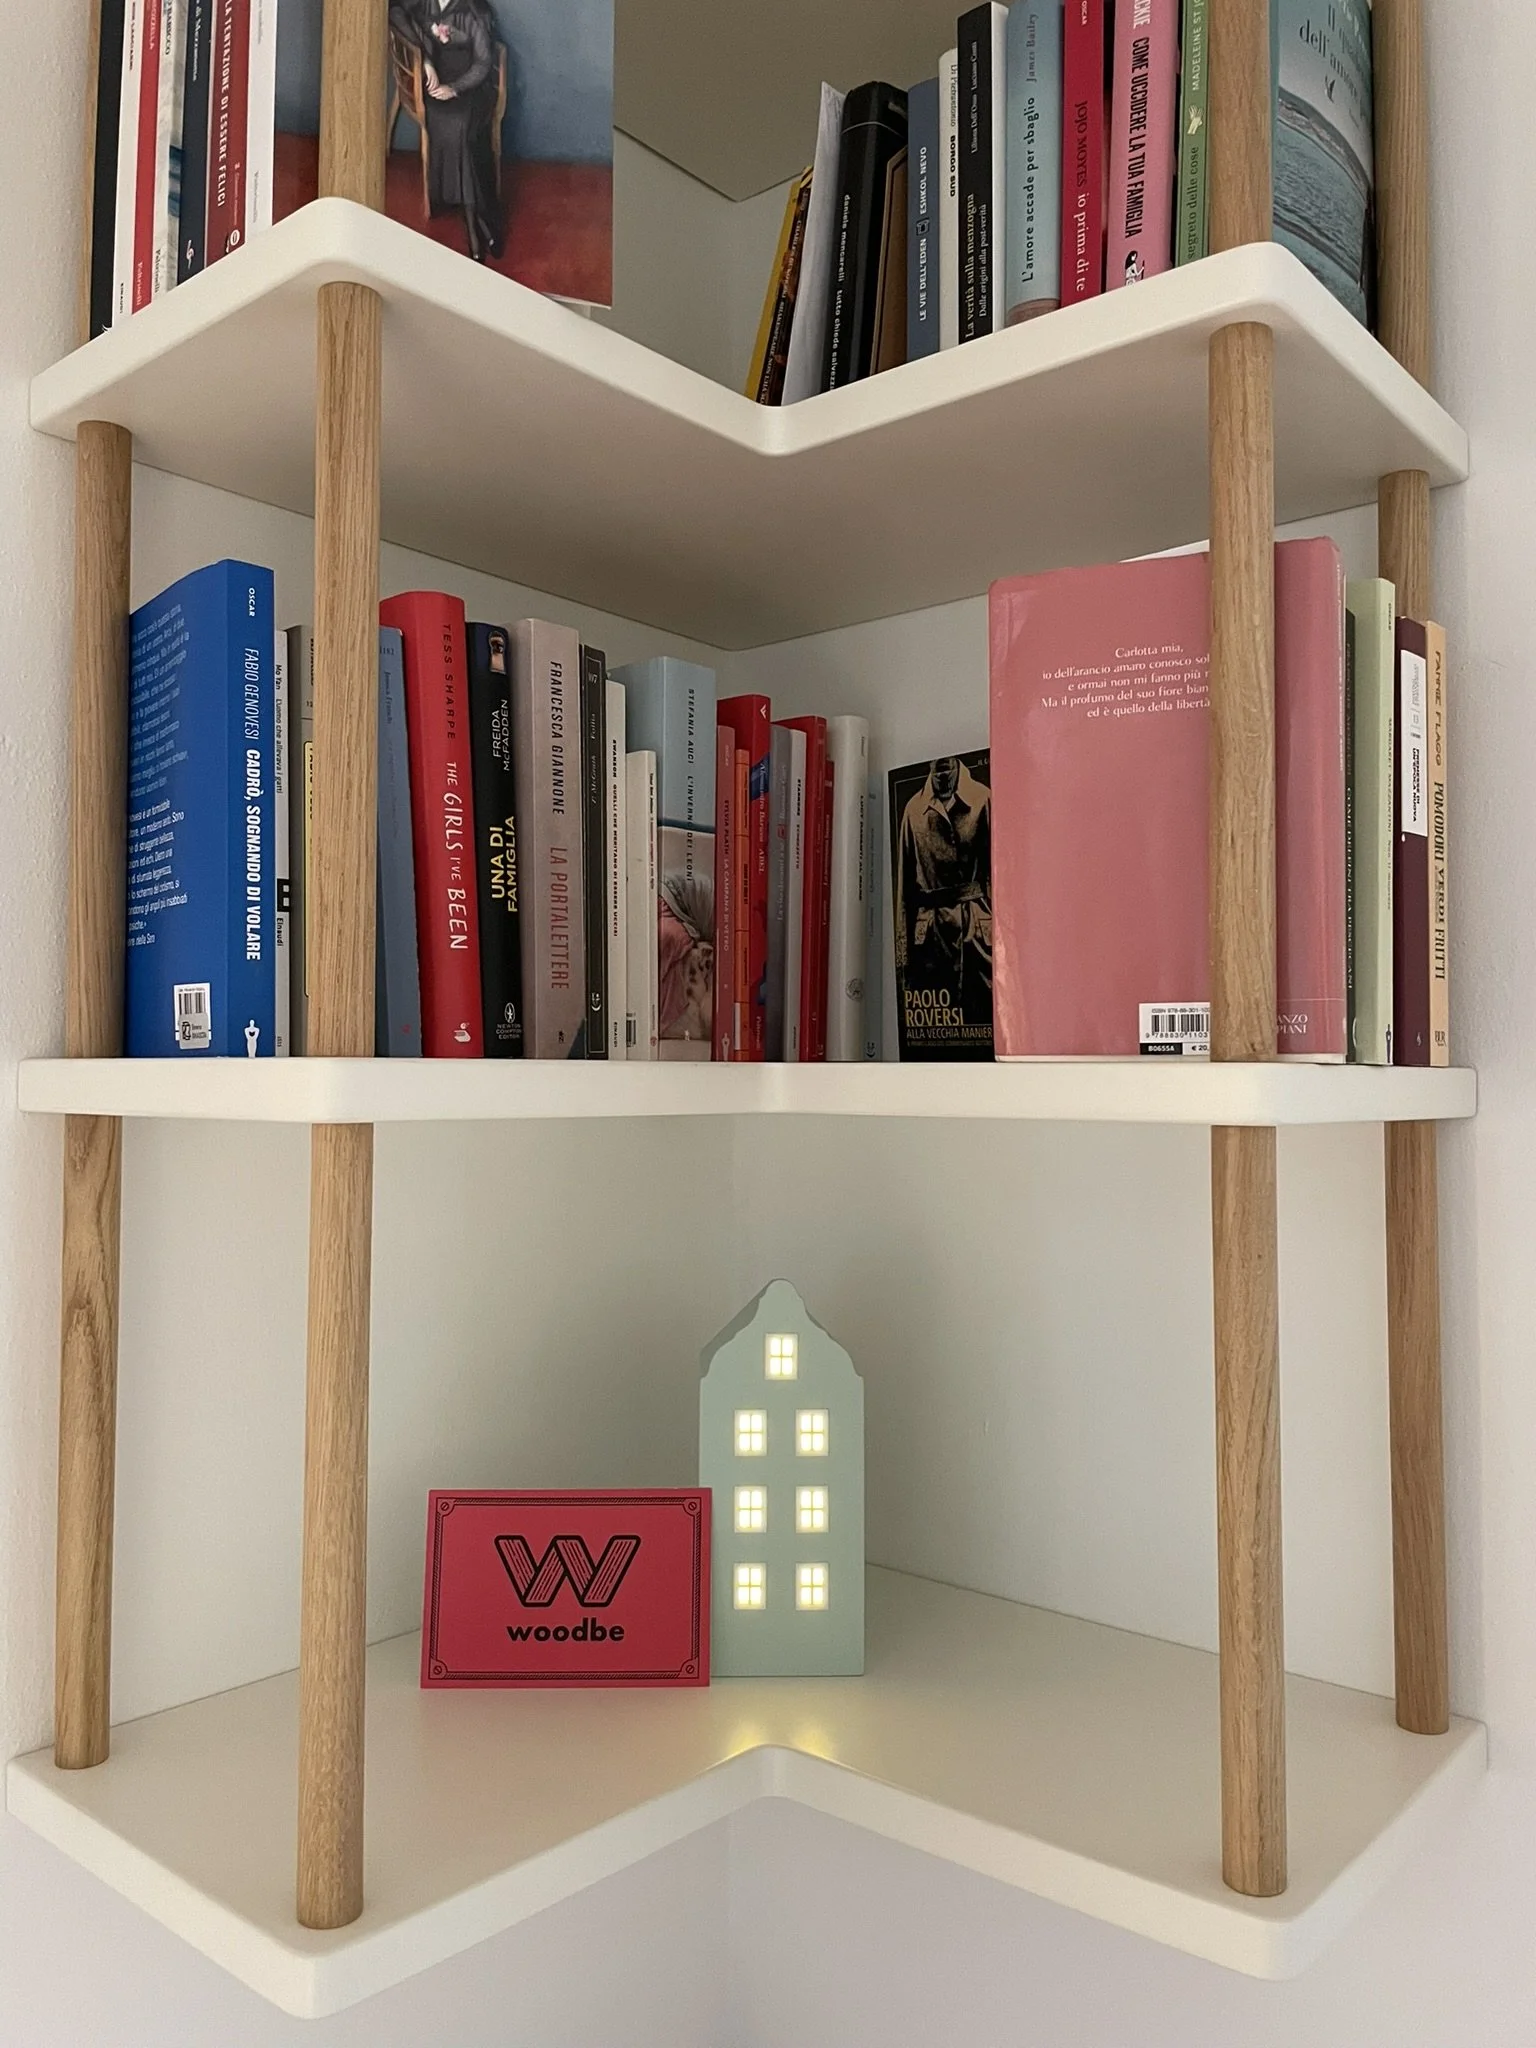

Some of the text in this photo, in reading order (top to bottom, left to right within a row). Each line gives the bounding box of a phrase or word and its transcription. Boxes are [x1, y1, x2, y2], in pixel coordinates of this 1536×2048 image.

[164, 3, 173, 56] BARICCO
[1026, 14, 1040, 83] James Bailey
[1192, 10, 1202, 91] MADELEINE ST
[221, 17, 232, 94] TENTAZIONE
[220, 96, 229, 110] DI
[218, 112, 228, 161] ESSERE
[1124, 36, 1150, 239] COME UCCIDERE LA TUA FAMIGLIA
[217, 163, 227, 207] FELICI
[1022, 97, 1040, 283] L'amore accade per sbaglio
[1073, 100, 1090, 292] JOJO MOYES io prima di te
[1186, 146, 1199, 260] segreto delle cose
[842, 194, 851, 229] daniele
[838, 232, 848, 282] mencarelli
[964, 193, 977, 338] La verità sulla menzogna
[978, 204, 989, 318] Dalle origini alla post-verità
[832, 318, 841, 349] chiede
[920, 310, 927, 321] LE
[248, 588, 256, 617] OSCAR
[275, 664, 282, 675] Mo
[1042, 672, 1052, 680] io
[1054, 666, 1111, 680] dell'arancio
[1114, 662, 1146, 673] amaro
[1149, 658, 1192, 669] conosco
[1114, 642, 1184, 659] Carlotta mia,
[1042, 683, 1209, 708] Ma il profumo del suo fiore bian
[1068, 683, 1075, 692] e
[1077, 678, 1107, 690] ormai
[1110, 677, 1130, 687] non
[1134, 674, 1148, 684] mi
[1151, 671, 1181, 684] fanno
[1183, 668, 1201, 683] più
[1087, 697, 1210, 718] ed è quello della libertà
[492, 710, 502, 758] FREIDA
[1434, 711, 1442, 767] FLAGG
[244, 648, 264, 960] FABIO GENOVESI CADRÒ, SOGNANDO DI VOLARE
[274, 776, 283, 794] gatti
[442, 624, 468, 950] TESS SHARPE THE GIRLS I'VE BEEN
[550, 661, 570, 989] FRANCESCA GIANNONE LA PORTALETTERE
[686, 832, 694, 848] DEI
[1434, 781, 1445, 862] POMODORI
[489, 826, 506, 899] UNA DI
[504, 816, 518, 913] FAMIGLIA
[1436, 867, 1445, 926] VERDI
[276, 917, 284, 947] Einaudi
[1434, 928, 1446, 980] FRITTI
[904, 988, 950, 1008] PAOLO
[905, 1008, 964, 1027] ROVERSI
[906, 1028, 926, 1039] ALLA
[926, 1028, 960, 1039] VECCHIA
[506, 1617, 625, 1643] woodbe
